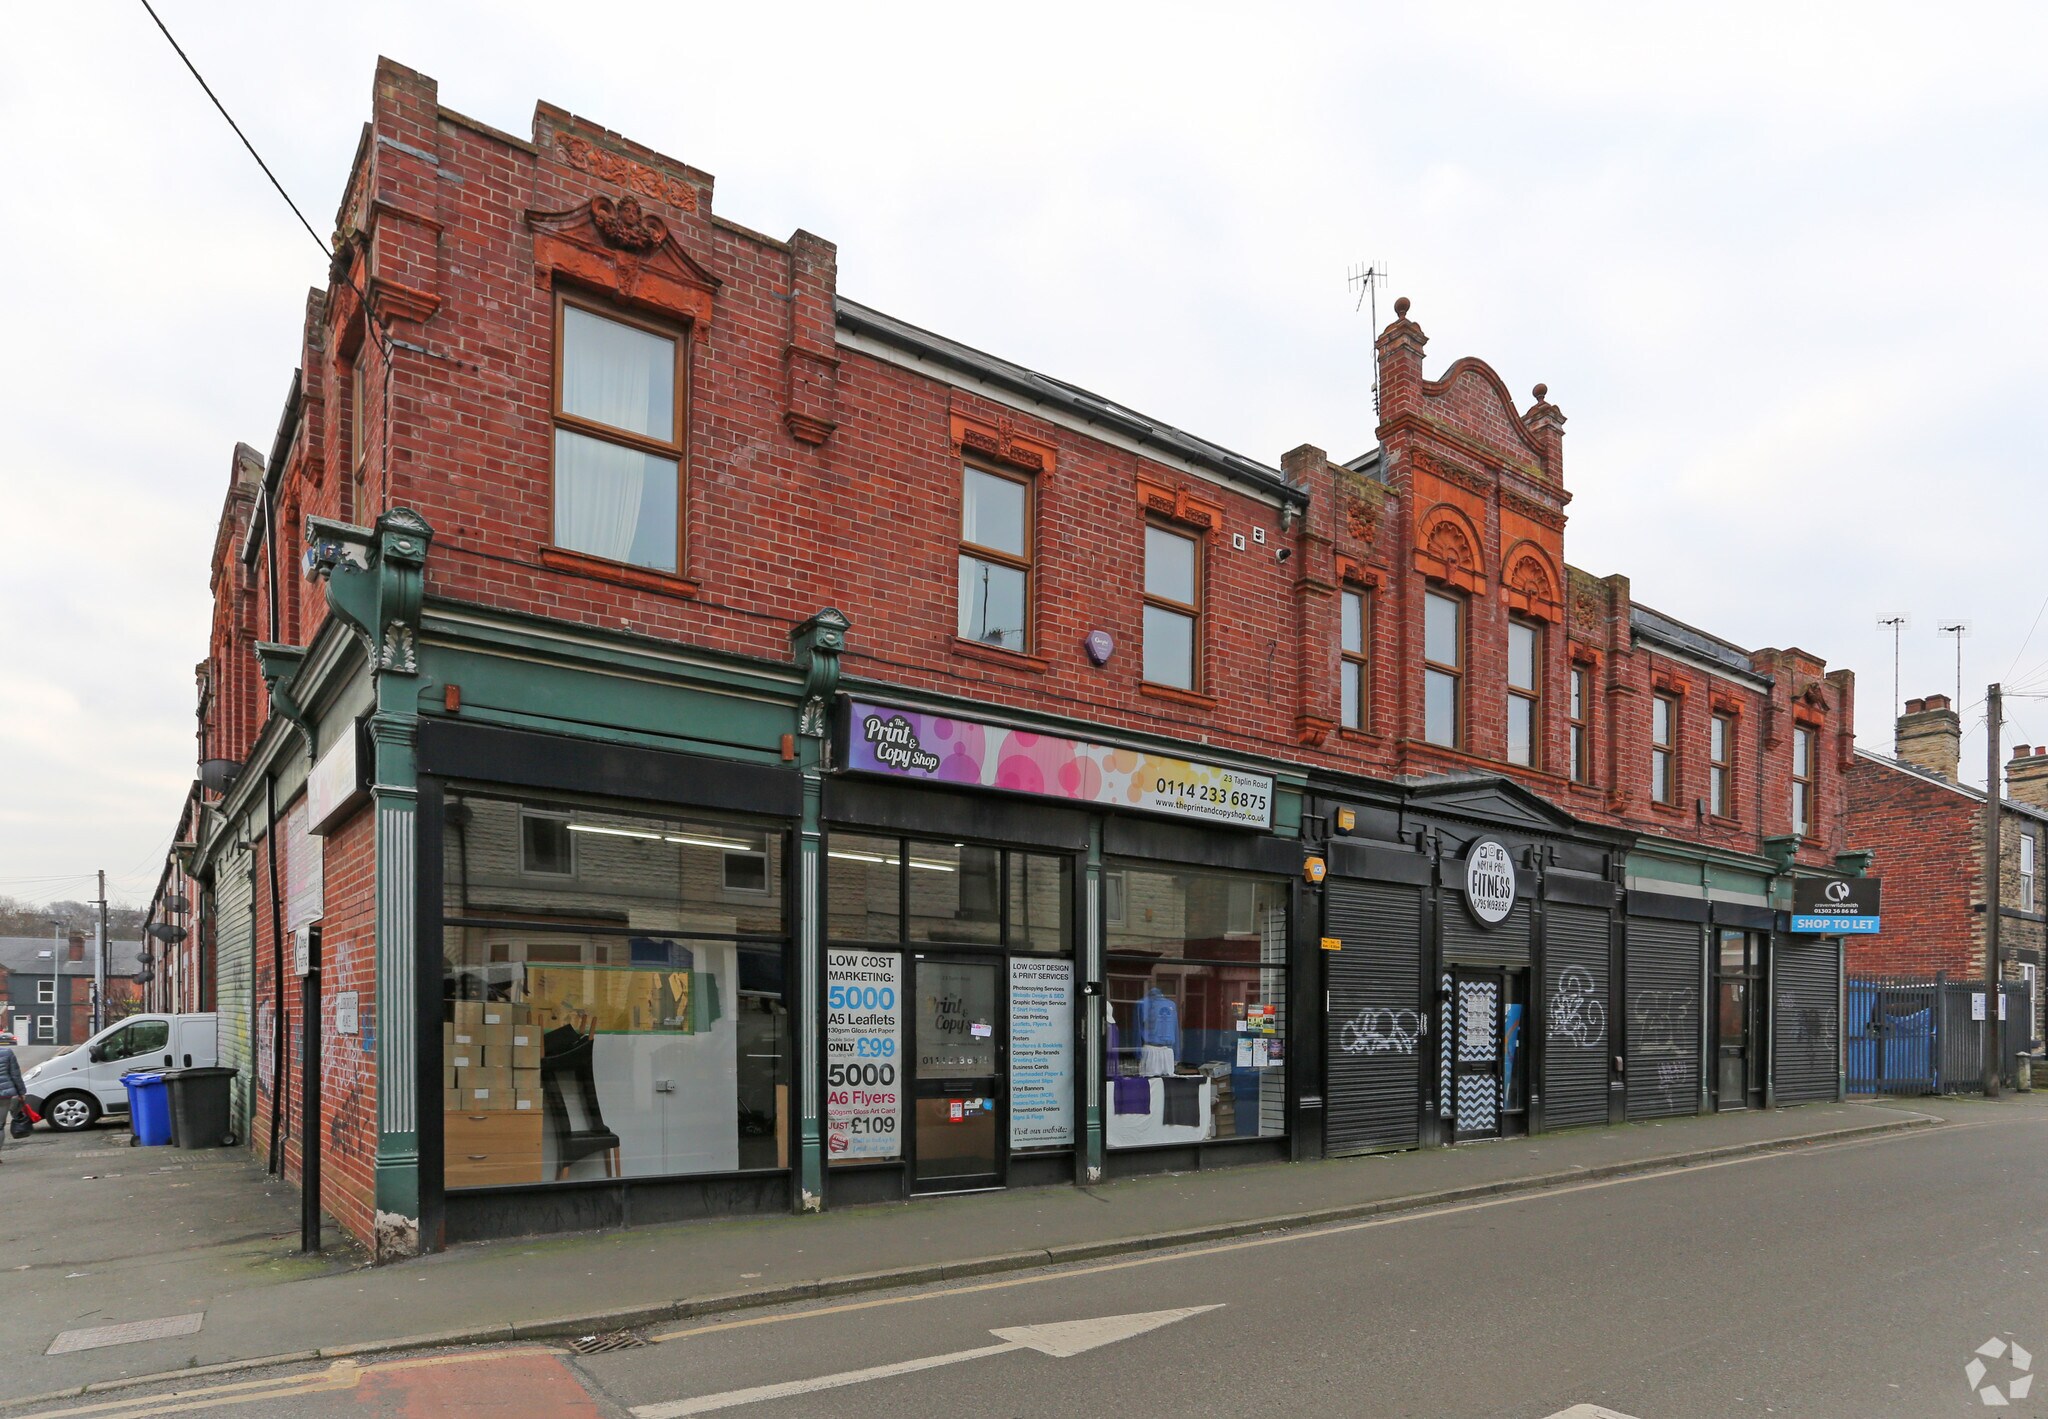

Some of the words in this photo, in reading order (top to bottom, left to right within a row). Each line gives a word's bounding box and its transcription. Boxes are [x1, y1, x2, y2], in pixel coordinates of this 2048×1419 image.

[894, 718, 905, 726] The
[866, 718, 910, 744] Print
[909, 738, 916, 748] &
[877, 742, 912, 768] Copy
[912, 752, 937, 770] Shop
[1224, 774, 1232, 782] 23
[1234, 776, 1252, 786] Taplin
[1252, 780, 1268, 789] Road
[1156, 778, 1195, 798] 0114
[1200, 786, 1226, 804] 233
[1231, 791, 1266, 810] 6875
[1156, 799, 1265, 822] www.theprintandcopyshop.co.uk
[1472, 870, 1510, 898] FITNESS
[1798, 919, 1830, 928] SHOP
[1833, 920, 1850, 929] TO
[1852, 920, 1874, 929] LET
[829, 955, 858, 966] LOW
[861, 956, 894, 968] COST
[829, 971, 894, 982] MARKETING:
[829, 986, 894, 1010] 5000
[828, 1013, 844, 1024] A5
[848, 1014, 895, 1025] Leaflets
[936, 1015, 965, 1034] Copy
[828, 1043, 855, 1052] ONLY
[857, 1037, 895, 1057] £99
[828, 1063, 895, 1086] 5000
[828, 1091, 848, 1104] A6
[852, 1091, 896, 1106] Flyers
[828, 1122, 849, 1130] JUST
[851, 1117, 895, 1134] £109
